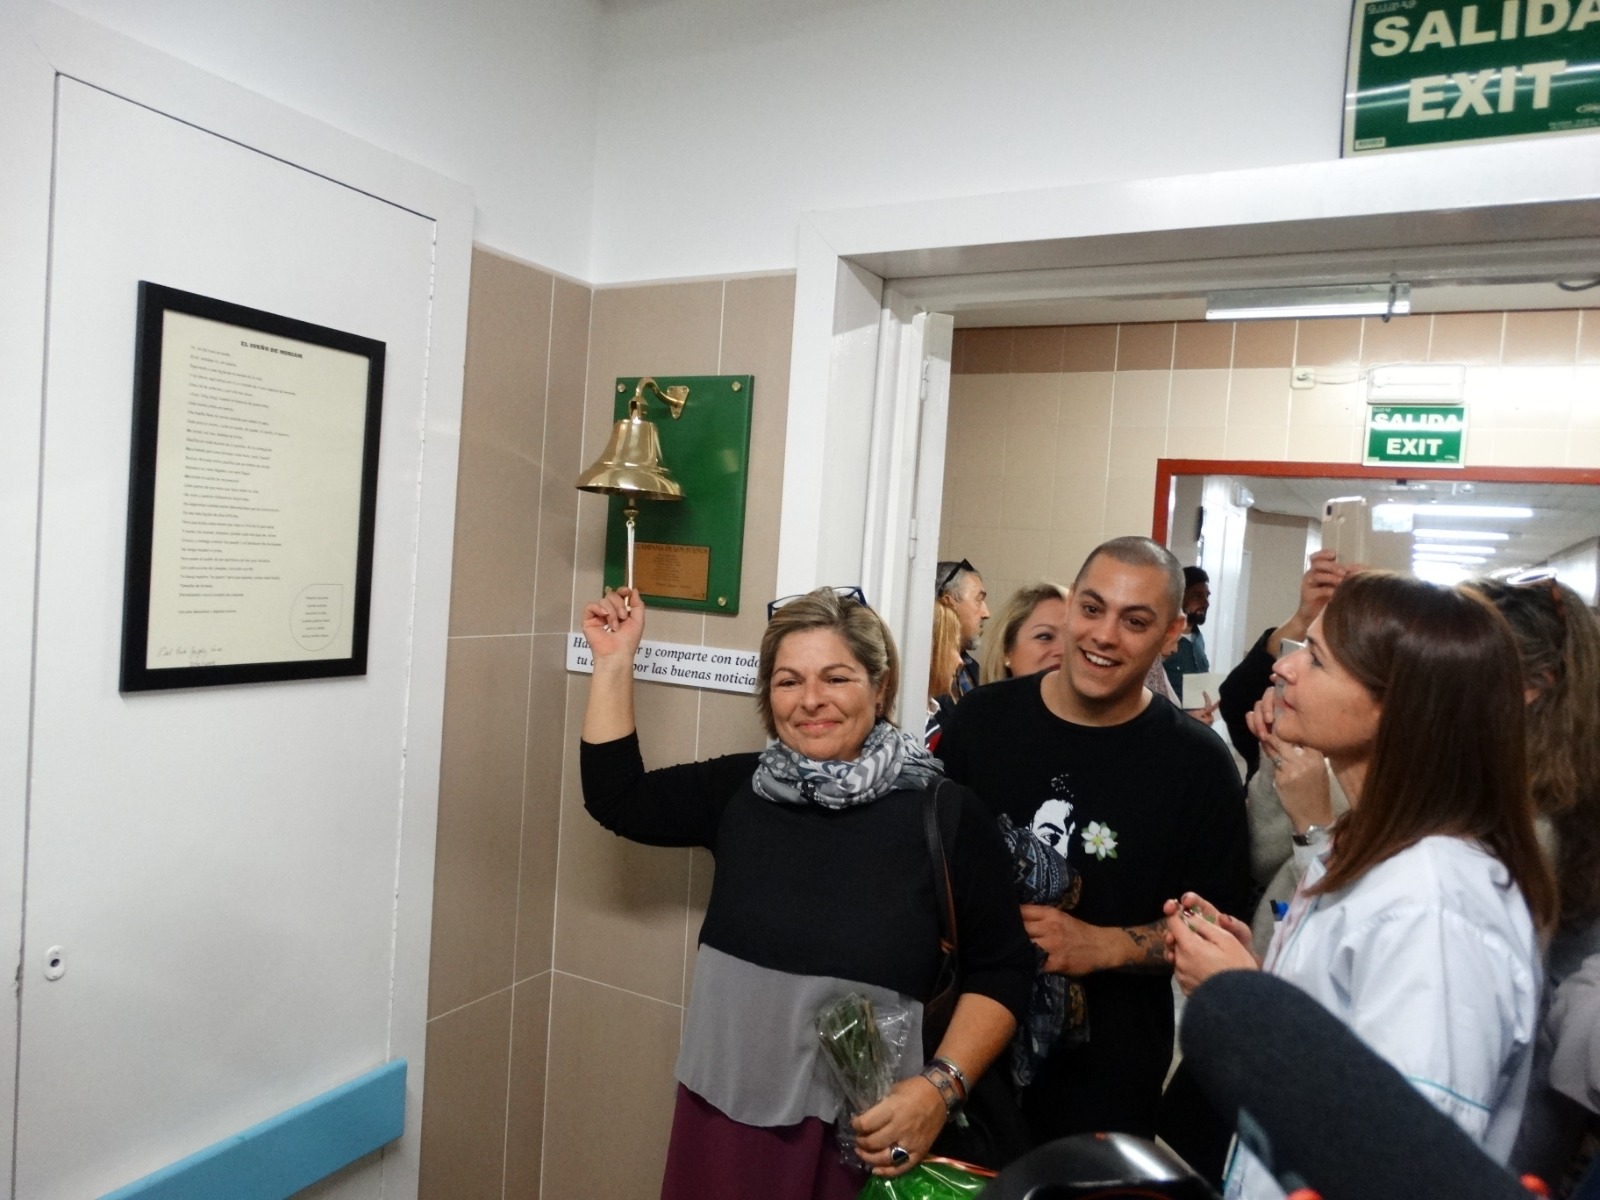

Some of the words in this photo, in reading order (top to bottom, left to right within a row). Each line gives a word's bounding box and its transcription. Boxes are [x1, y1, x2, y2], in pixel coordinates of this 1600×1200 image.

[1370, 0, 1600, 57] SALIDA
[1407, 60, 1567, 123] EXIT
[1374, 413, 1460, 430] SALIDA
[1386, 438, 1443, 456] EXIT
[573, 637, 591, 648] Ha
[644, 647, 652, 658] y
[655, 647, 707, 661] comparte
[711, 655, 732, 665] con
[736, 655, 760, 668] todo
[577, 656, 588, 665] tu
[652, 662, 668, 675] las
[671, 664, 711, 680] buenas
[715, 673, 756, 686] noticia
